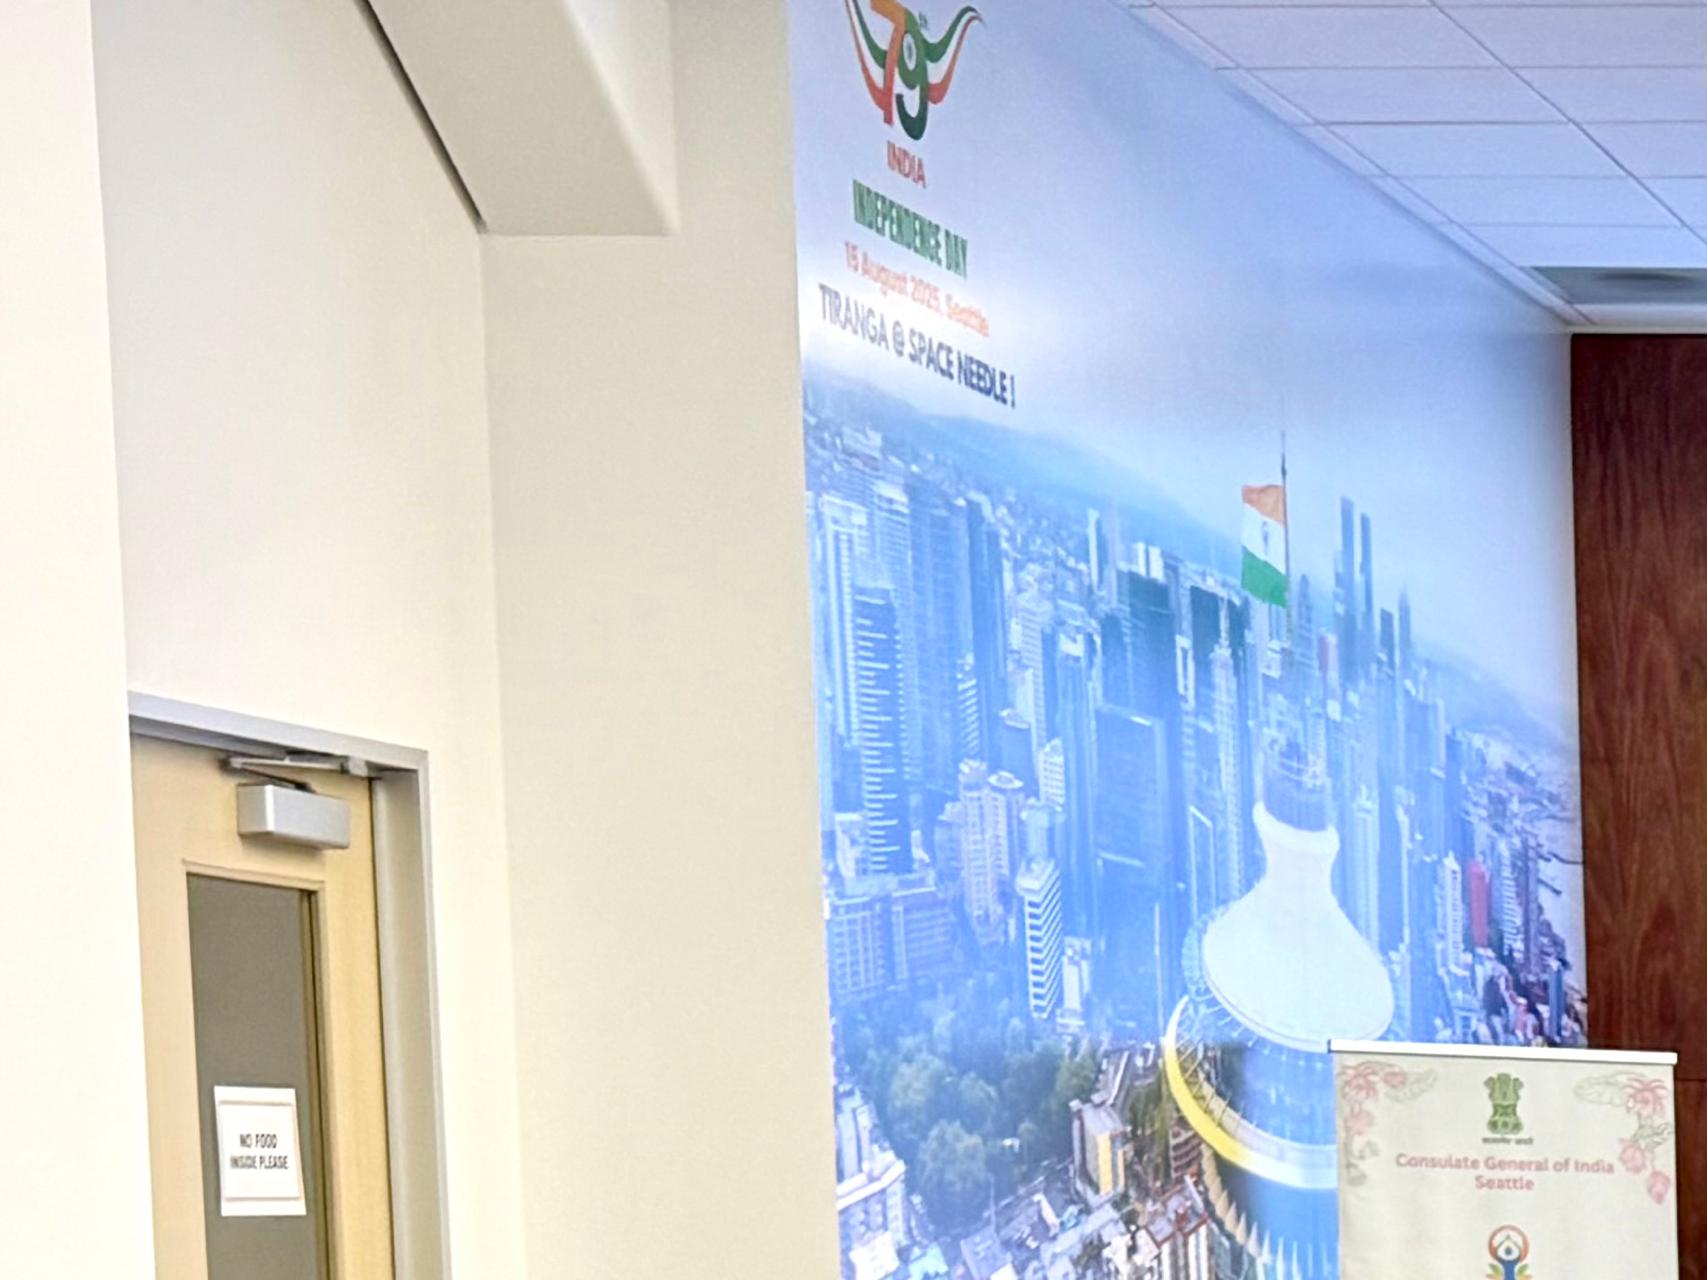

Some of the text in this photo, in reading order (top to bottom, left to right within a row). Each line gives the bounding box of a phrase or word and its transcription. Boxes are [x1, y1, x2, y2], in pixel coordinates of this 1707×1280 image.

[887, 140, 926, 188] INDIA
[853, 179, 968, 280] INDEPENDENCE DAY
[845, 241, 859, 272] 15
[861, 252, 908, 297] August
[818, 283, 889, 352] TIRANGA
[892, 320, 905, 357] @
[909, 328, 954, 380] SPACE
[957, 353, 1008, 405] NEEDLE
[239, 1133, 277, 1149] NO FOOD
[259, 1155, 288, 1170] PLEASE
[1395, 1153, 1615, 1174] Consulate General of India
[1475, 1174, 1534, 1191] Seattle
